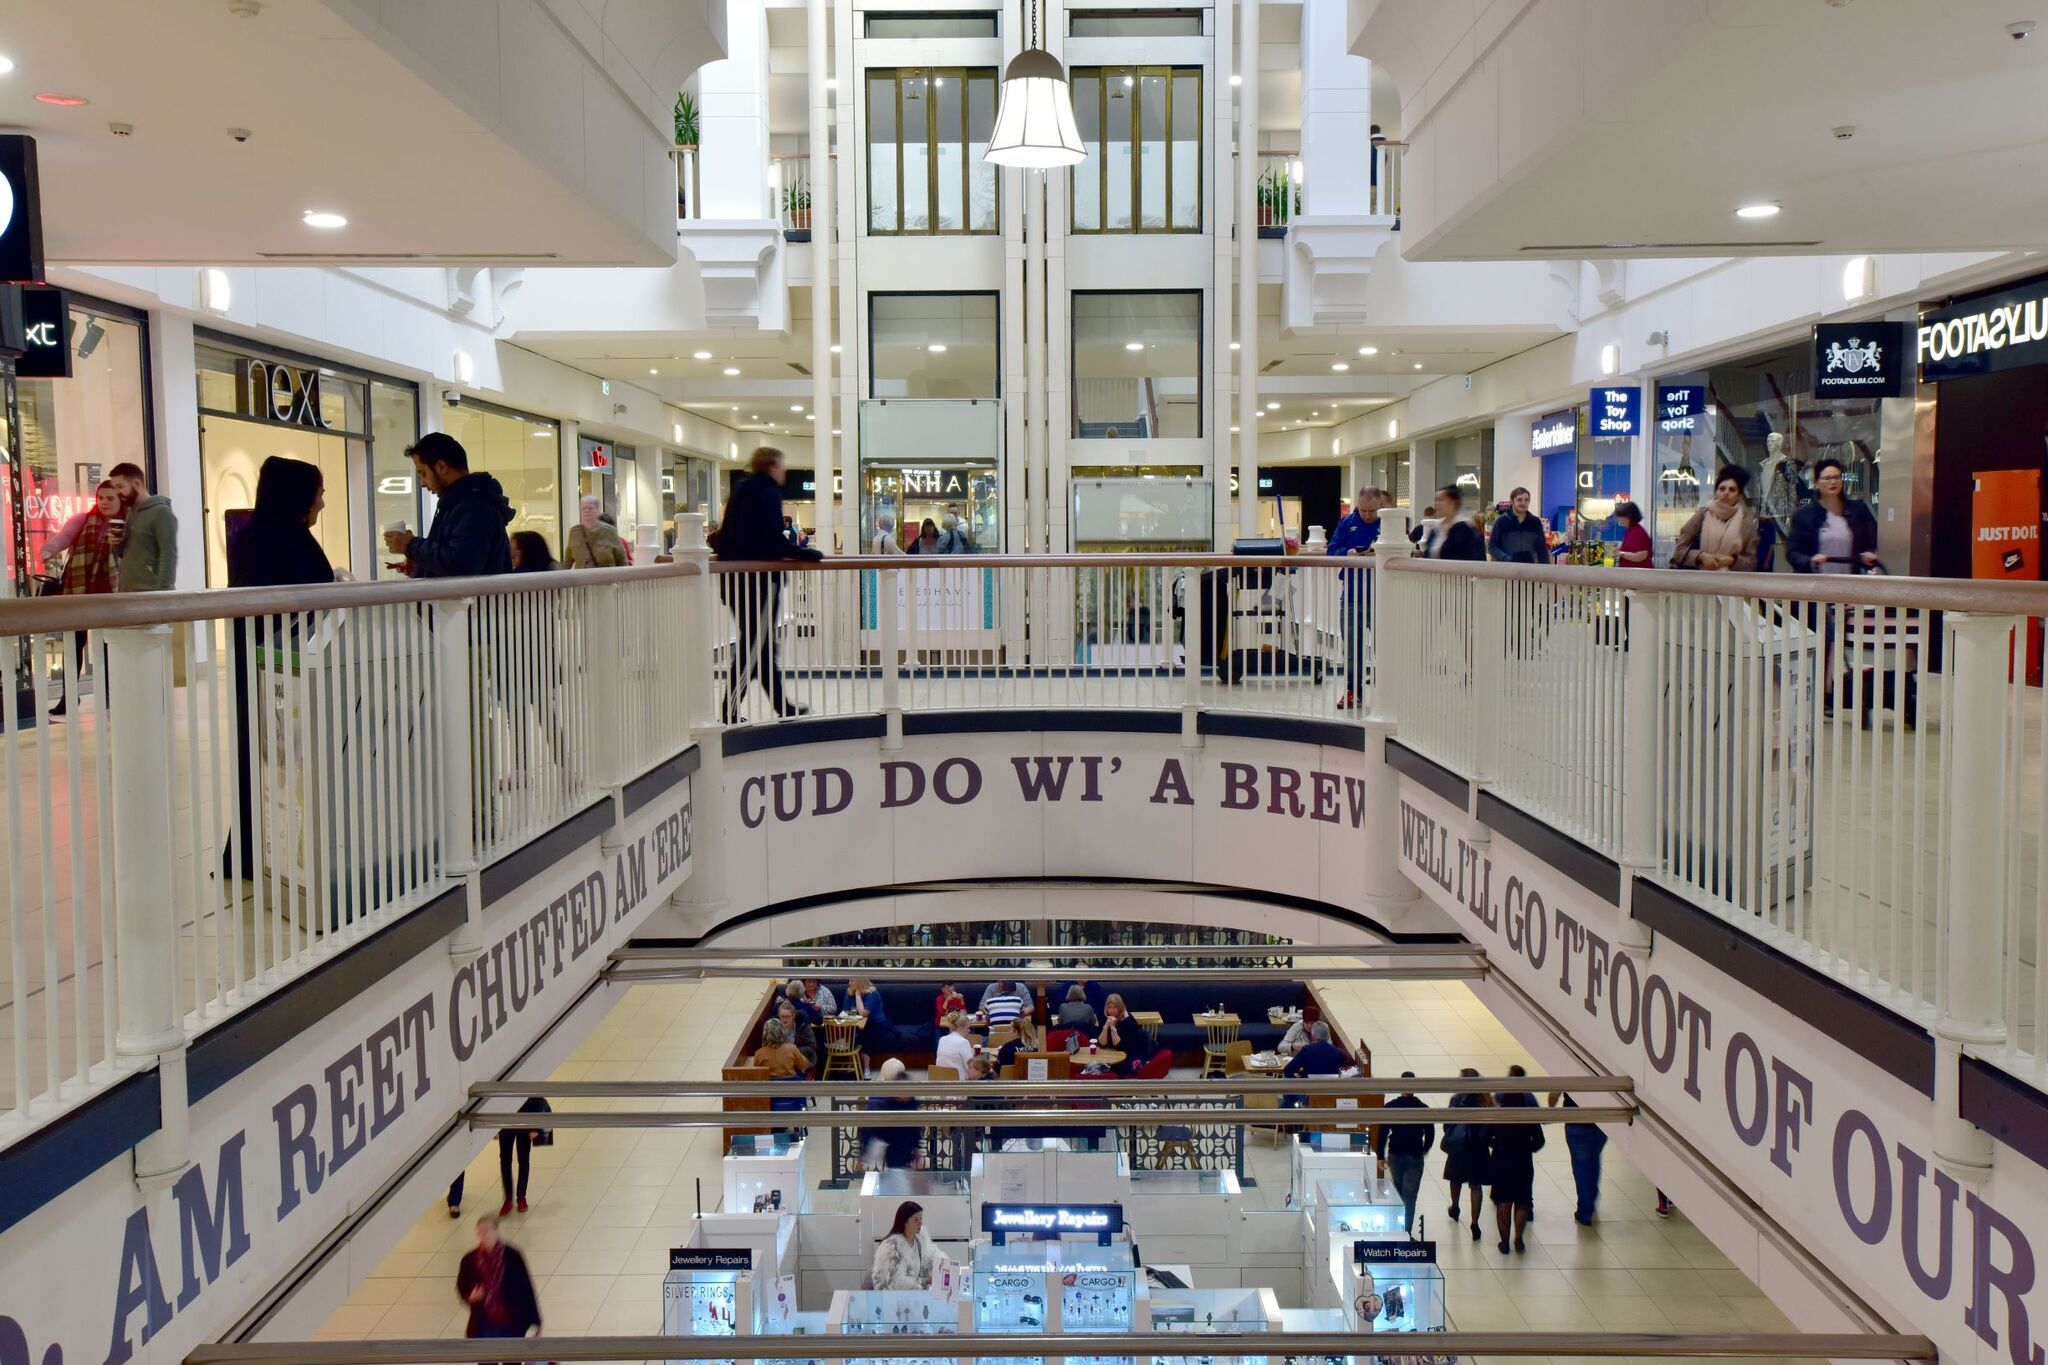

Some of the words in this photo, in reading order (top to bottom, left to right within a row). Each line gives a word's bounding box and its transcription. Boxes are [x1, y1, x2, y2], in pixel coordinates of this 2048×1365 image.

[26, 322, 57, 346] xt
[247, 359, 333, 429] next
[1605, 391, 1627, 402] The
[1605, 405, 1627, 419] Toy
[1600, 419, 1632, 432] Shop
[1977, 526, 2010, 541] JUST
[2011, 526, 2029, 540] DO
[739, 767, 854, 828] CUD
[880, 757, 983, 808] DO
[1011, 756, 1122, 802] WI'
[1150, 758, 1195, 805] A
[1401, 799, 1452, 894] WELL
[1457, 838, 1498, 934] I'LL
[1505, 875, 1547, 970] GO
[1555, 908, 1711, 1103] T'FOOT
[1724, 1032, 1813, 1178] OF
[1832, 1109, 2046, 1365] OUR
[102, 1128, 251, 1365] AM
[272, 992, 435, 1223] REET
[449, 869, 607, 1062] CHUFFED
[614, 836, 648, 925] AM
[994, 1210, 1056, 1228] Jewellery
[1057, 1210, 1108, 1228] Repairs
[672, 1255, 713, 1266] Jewellery
[715, 1255, 749, 1265] Repairs
[1363, 1248, 1391, 1257] Watch
[1393, 1248, 1427, 1259] Repairs
[994, 1278, 1029, 1287] CARGO
[1081, 1277, 1117, 1286] CARGO
[665, 1286, 696, 1299] SILVER
[700, 1286, 729, 1298] RINGS
